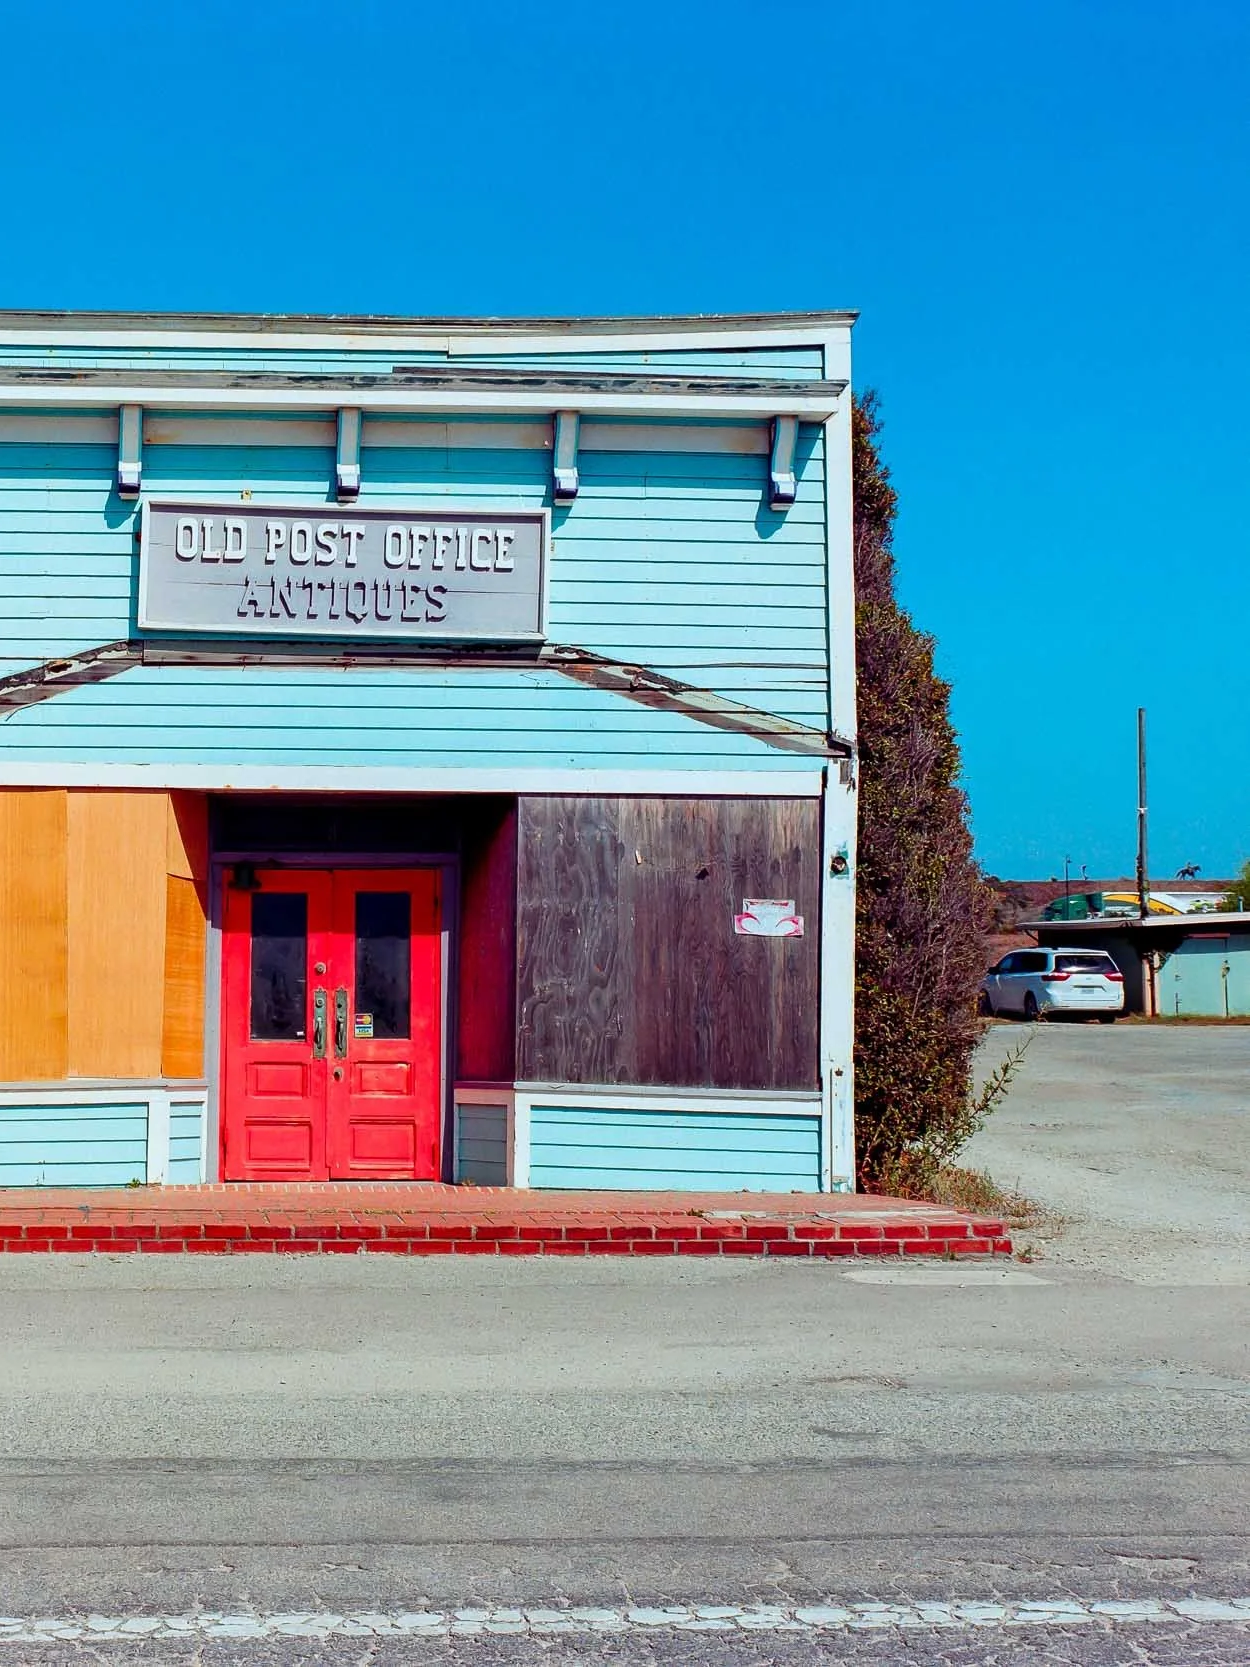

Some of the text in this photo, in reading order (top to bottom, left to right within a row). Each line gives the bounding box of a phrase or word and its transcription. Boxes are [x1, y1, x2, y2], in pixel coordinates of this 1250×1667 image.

[175, 517, 515, 573] OLD POST OFFICE
[237, 575, 448, 625] ANTIQUES
